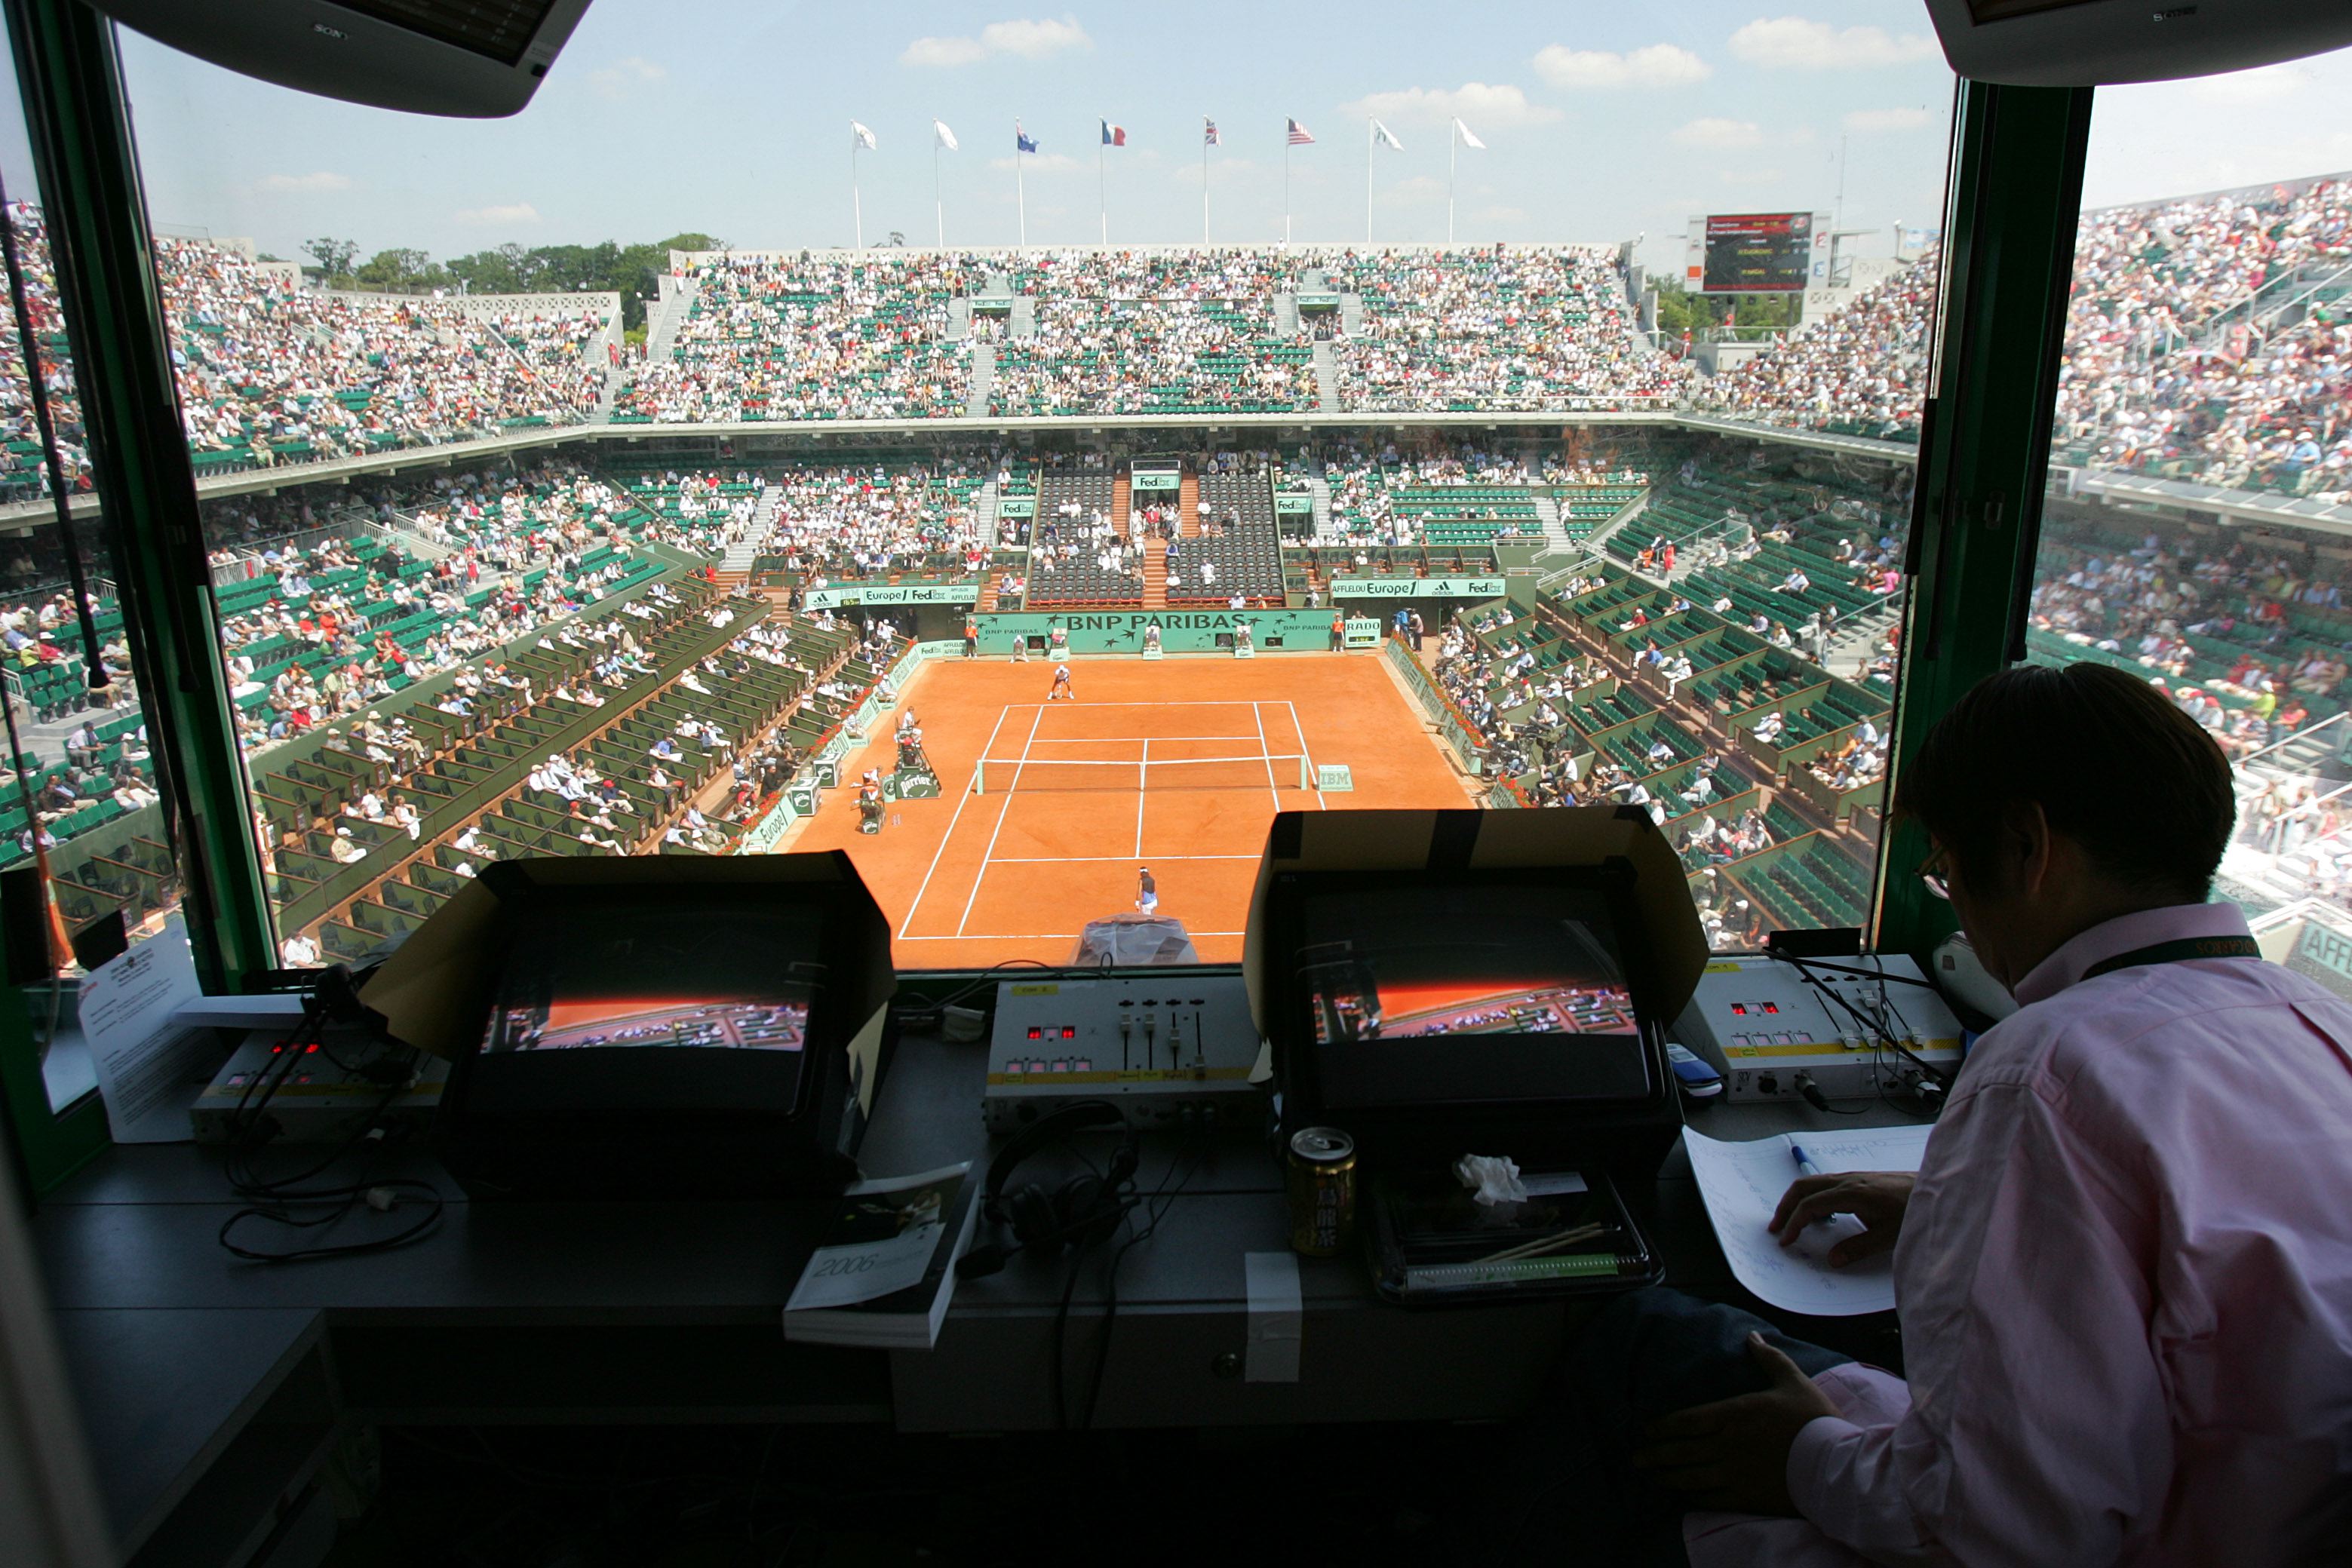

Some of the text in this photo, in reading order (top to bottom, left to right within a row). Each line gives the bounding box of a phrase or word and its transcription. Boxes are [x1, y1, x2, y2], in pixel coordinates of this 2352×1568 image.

[314, 23, 348, 40] SONY
[1140, 477, 1169, 486] FedEx
[1004, 504, 1032, 513] FedEx
[1278, 500, 1306, 509] FedEx
[1333, 584, 1365, 592] AFFLELOU
[1469, 582, 1501, 593] FedEx
[912, 590, 945, 600] FedEx
[1067, 613, 1245, 631] BNP PARIBAS
[1346, 621, 1380, 631] RADO
[1320, 772, 1349, 785] IBM
[812, 1253, 880, 1278] 2006
